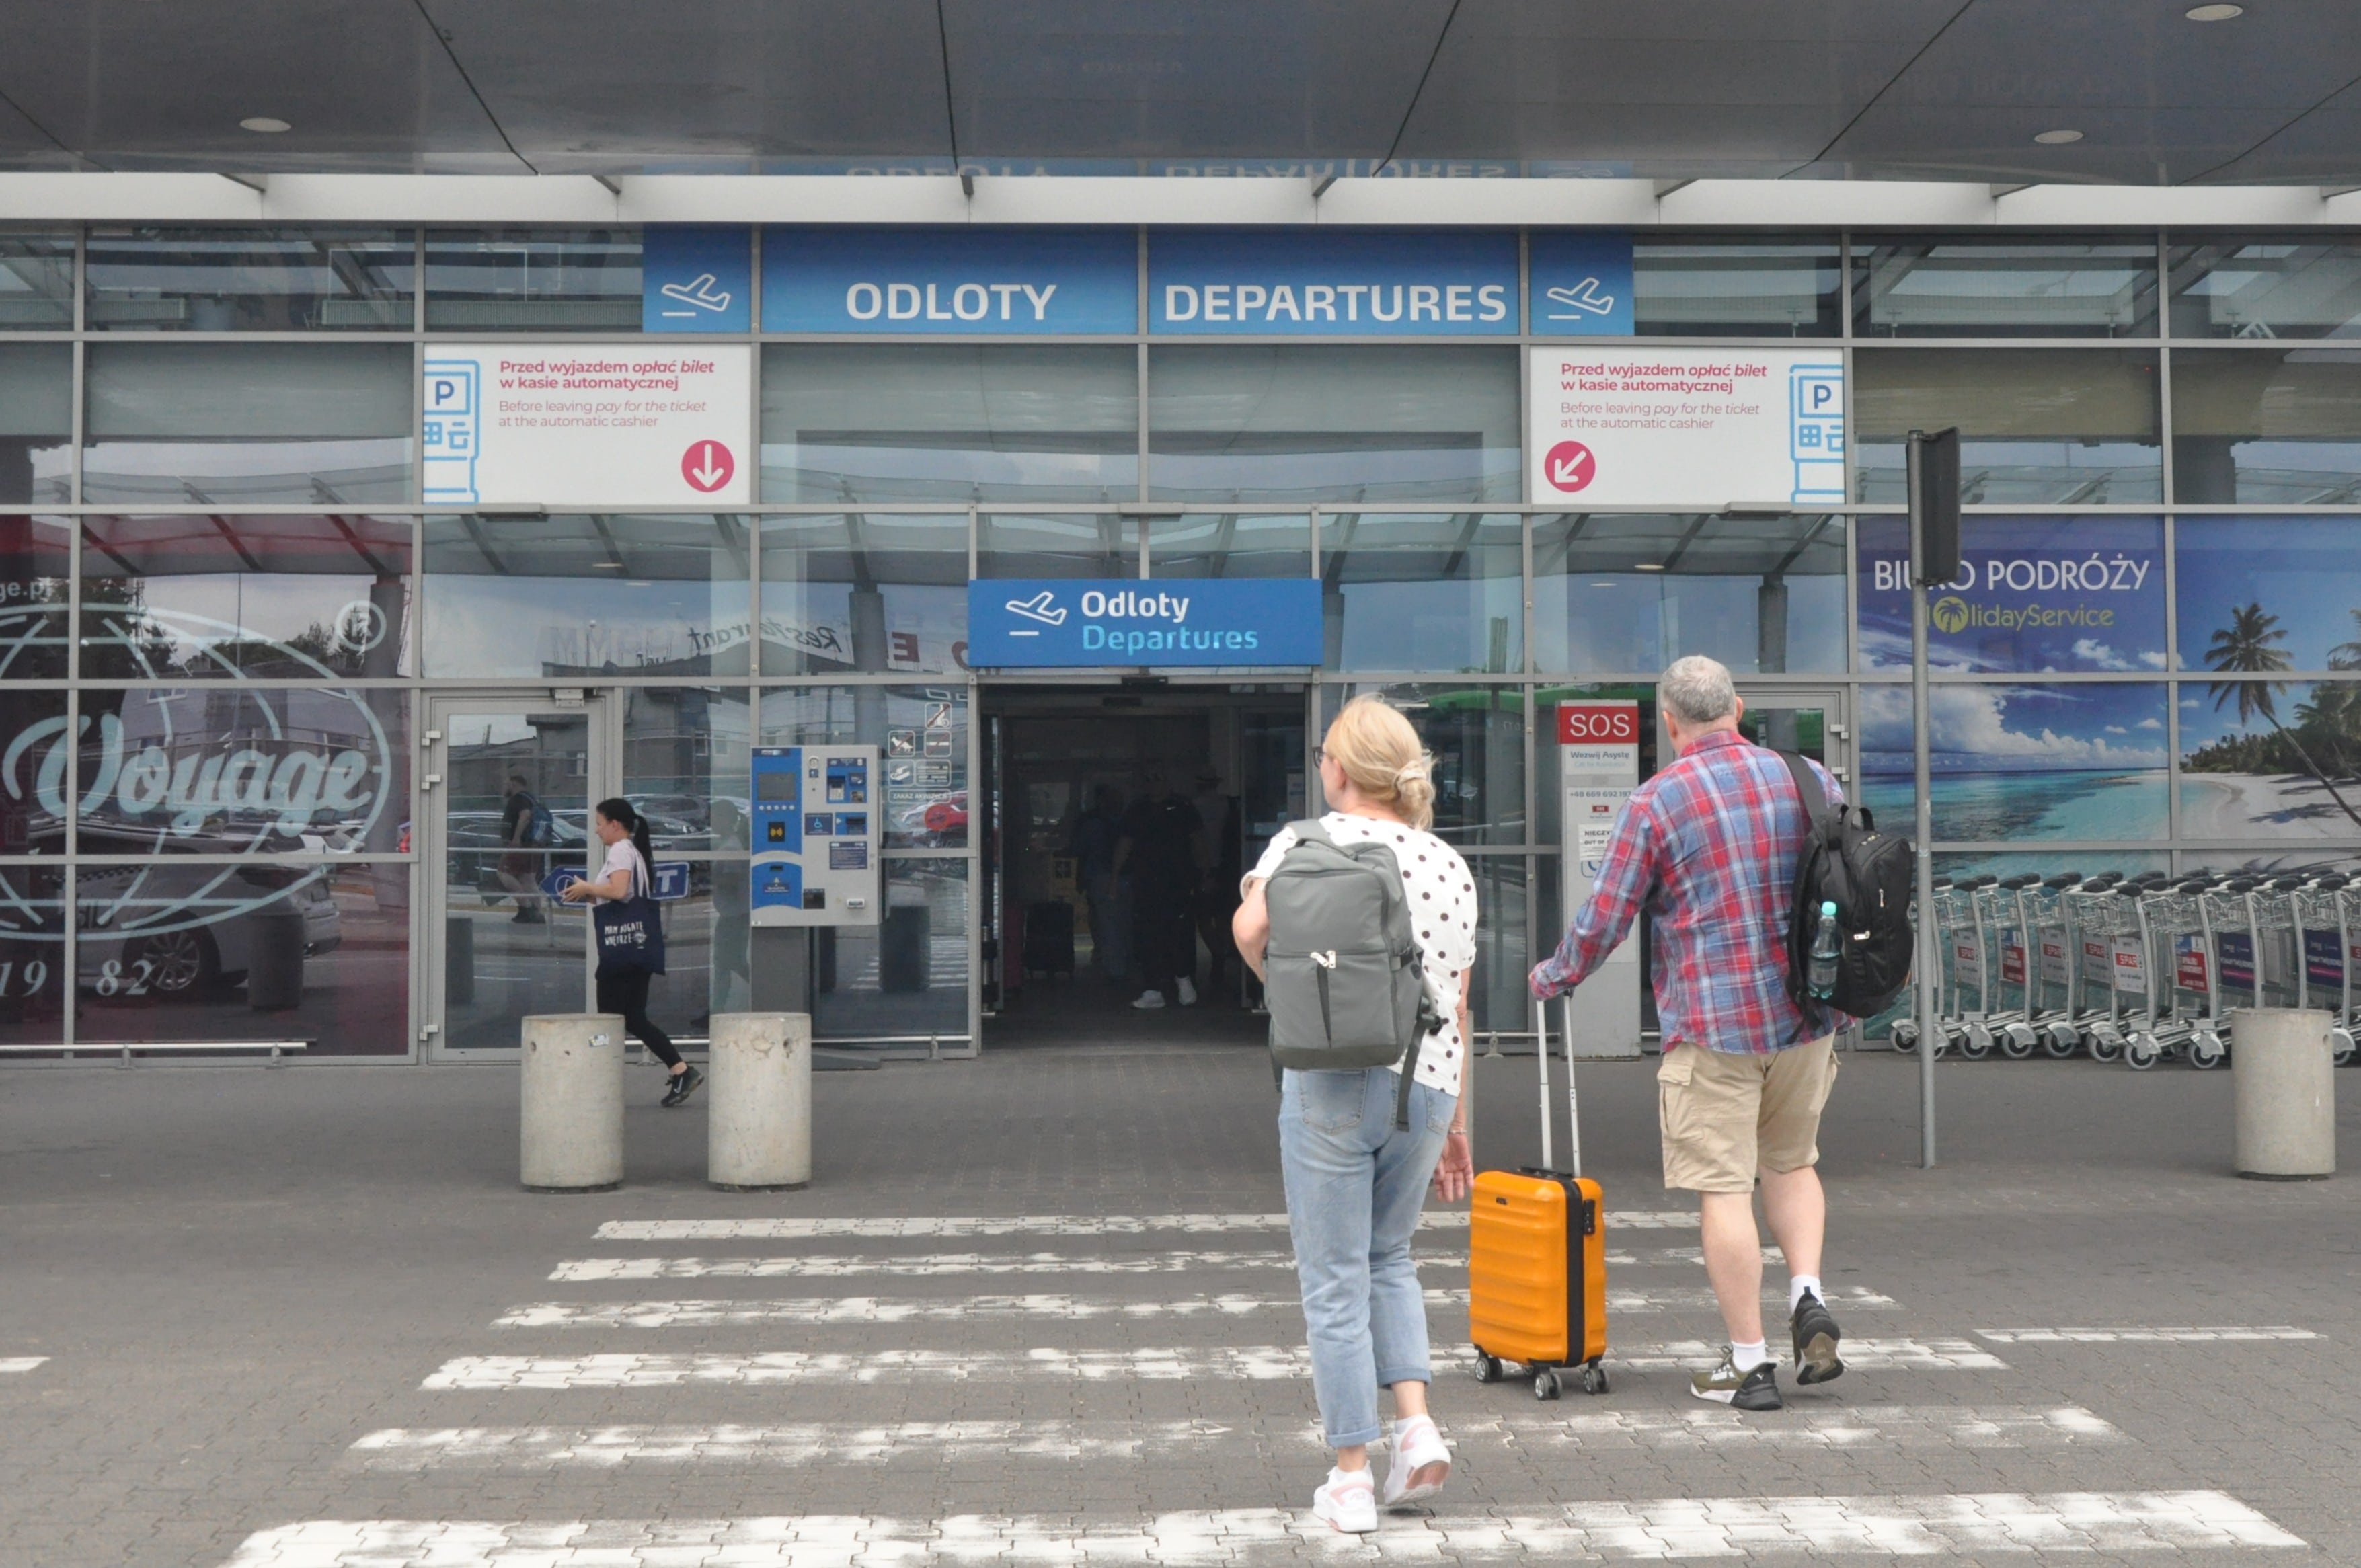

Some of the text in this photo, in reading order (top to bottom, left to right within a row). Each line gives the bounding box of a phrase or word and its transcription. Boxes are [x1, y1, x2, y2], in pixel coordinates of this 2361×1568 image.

[846, 283, 1056, 320] ODLOTY
[1165, 284, 1506, 322] DEPARTURES
[500, 360, 715, 377] Przed wyjazdem opłać bilet
[1561, 363, 1768, 379] Przed wyjazdem opłać bilet
[500, 376, 679, 391] w kasie automatycznej
[1561, 379, 1733, 395] w kasie automatycznej
[499, 401, 706, 415] Before leaving pay for the ticket
[1561, 403, 1760, 417] Before leaving pay for the ticket
[499, 416, 658, 427] at the automatic cashier
[1561, 418, 1715, 429] at the automatic cashier
[1988, 552, 2150, 591] PODRÓŻY
[1081, 590, 1190, 623] Odloty
[1083, 625, 1259, 656] Departures
[1570, 713, 1631, 738] SOS
[1570, 751, 1601, 760] Wezwij
[2, 713, 373, 838] Voyage
